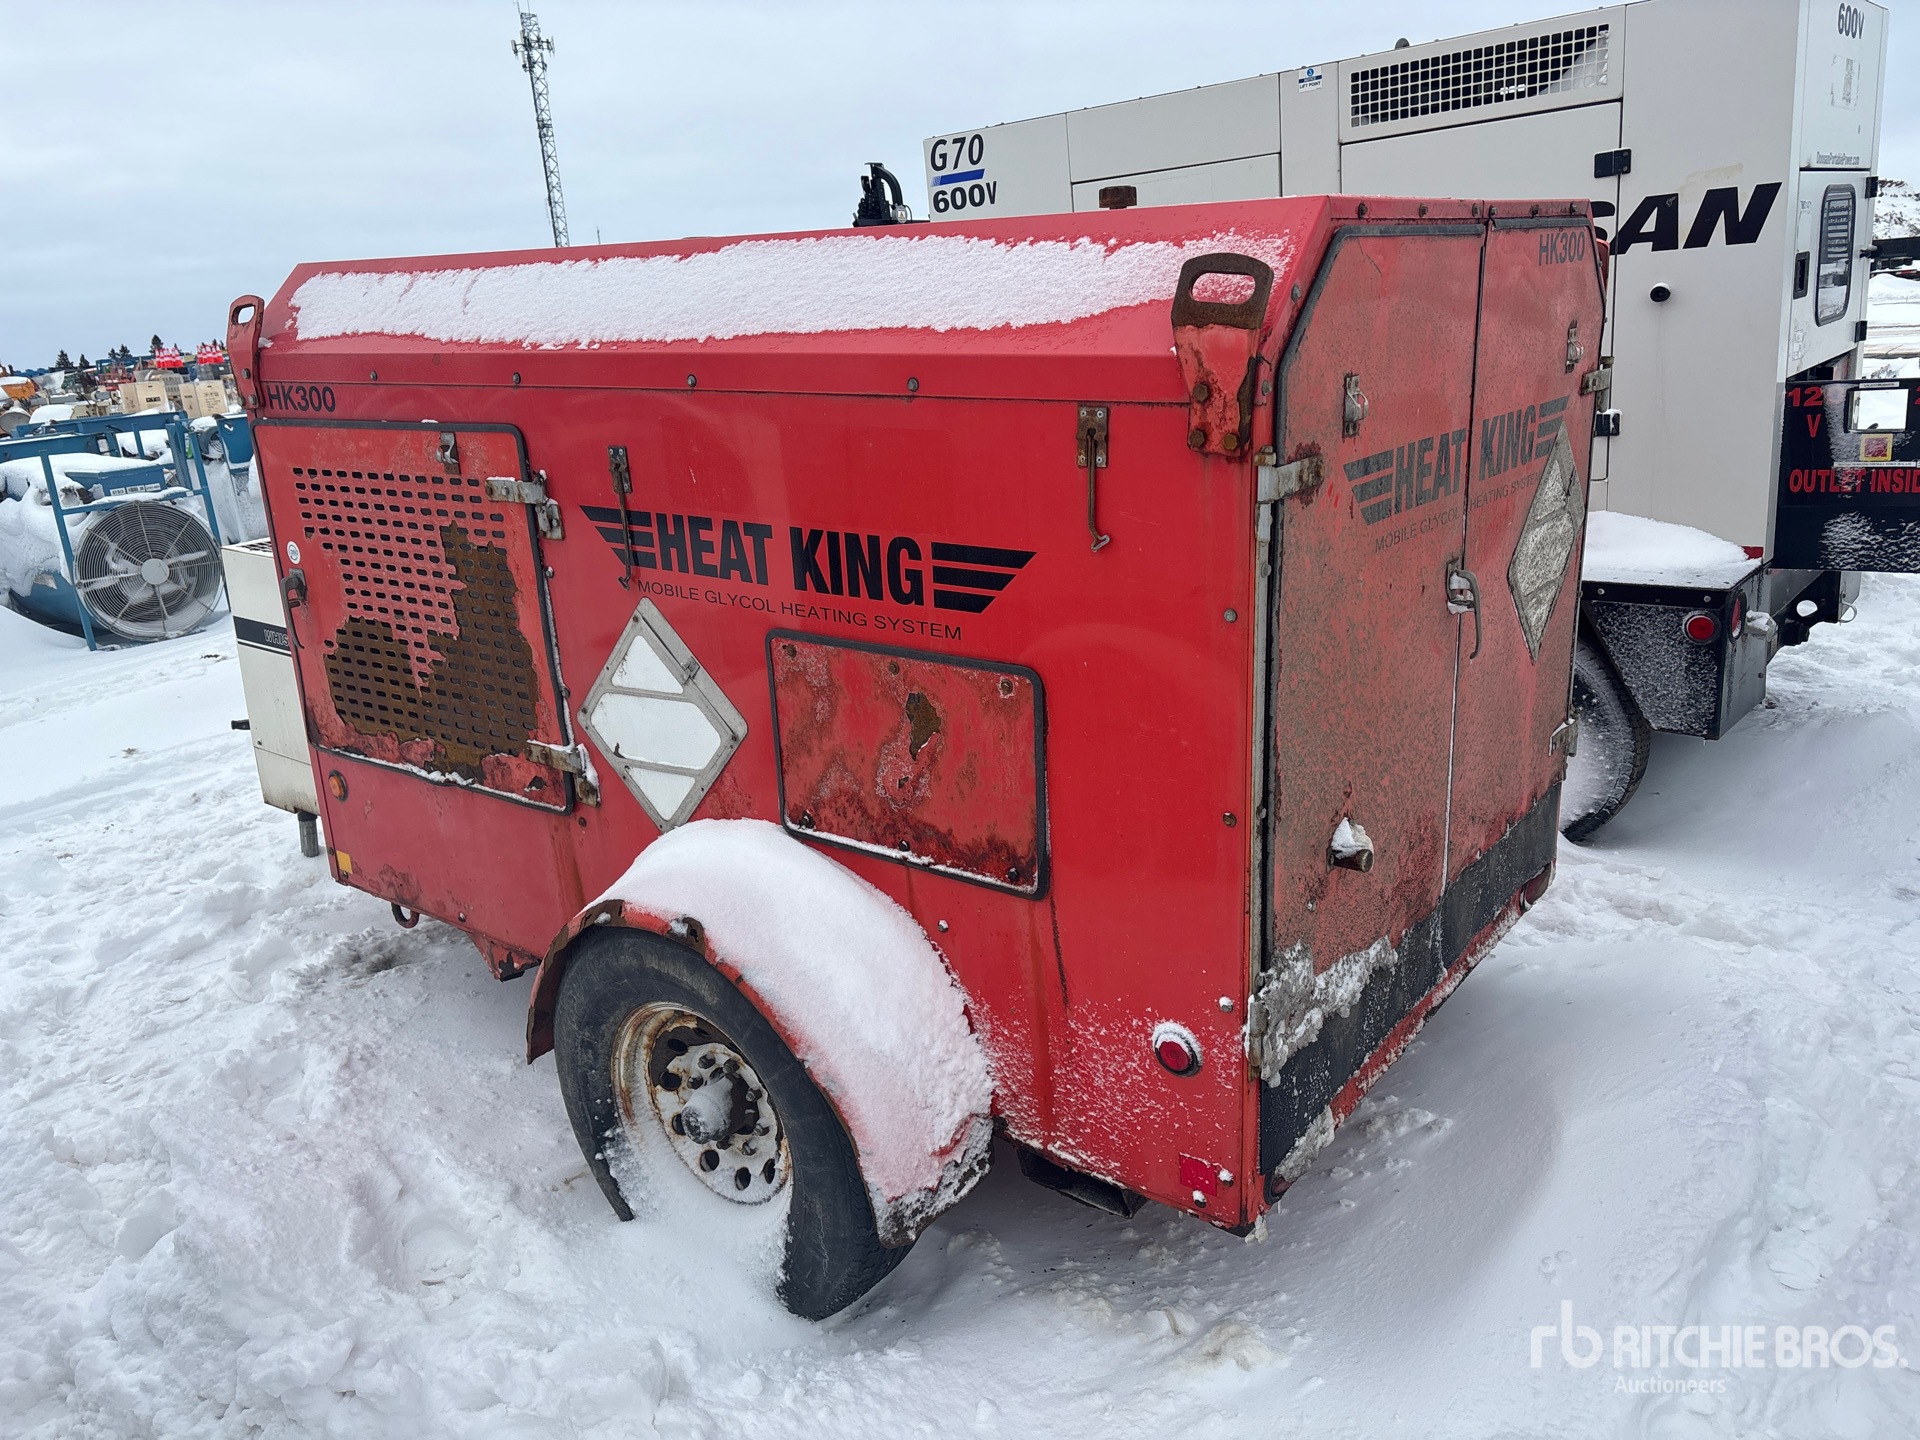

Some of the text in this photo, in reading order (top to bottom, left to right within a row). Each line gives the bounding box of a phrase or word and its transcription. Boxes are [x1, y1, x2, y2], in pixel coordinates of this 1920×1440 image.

[1837, 2, 1865, 39] 600V
[930, 133, 984, 171] G70
[932, 181, 997, 214] 600V
[1538, 231, 1586, 266] HK300
[267, 385, 336, 413] HK300
[1807, 414, 1822, 438] V
[1395, 406, 1536, 515] HEAT KING
[1789, 468, 1866, 493] OUTLET
[1375, 522, 1418, 553] MOBILE
[1420, 507, 1459, 534] GLYCOL
[1471, 486, 1509, 510] HEATING
[655, 512, 924, 607] HEAT KING
[637, 579, 963, 641] MOBILE GLYCOL HEATING SYSTEM
